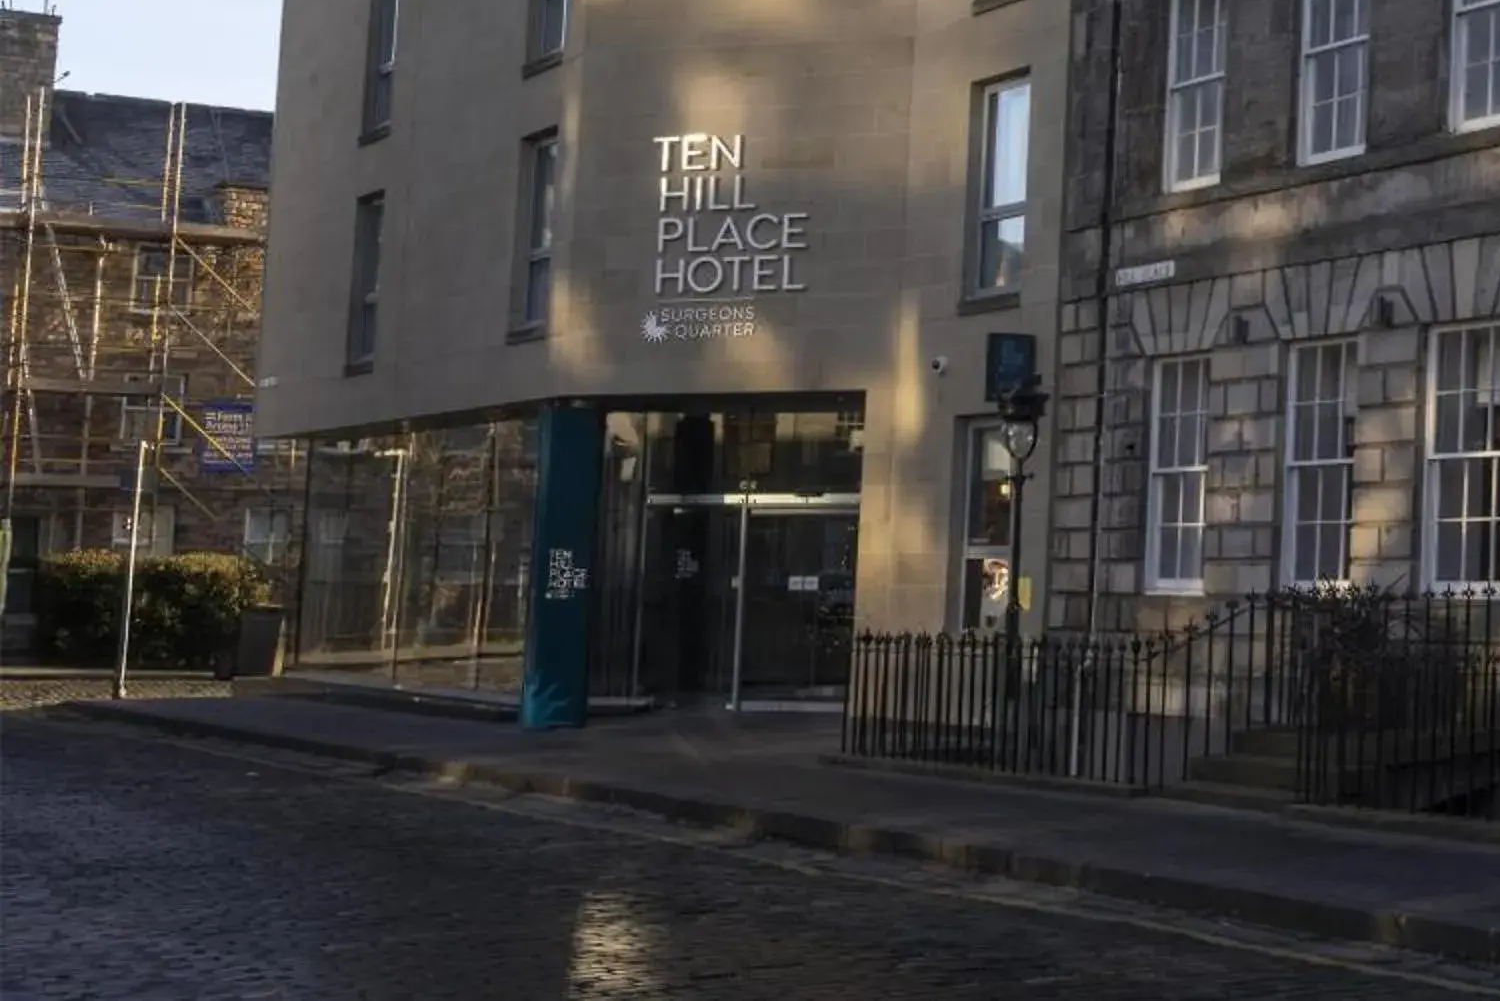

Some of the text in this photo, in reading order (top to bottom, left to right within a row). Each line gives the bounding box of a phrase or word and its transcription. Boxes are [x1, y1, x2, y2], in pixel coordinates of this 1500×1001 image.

[653, 133, 743, 172] TEN
[659, 175, 756, 212] HILL
[657, 212, 809, 252] PLACE
[654, 254, 806, 294] HOTEL
[660, 305, 756, 322] SURGEONS
[675, 322, 755, 340] QUARTER
